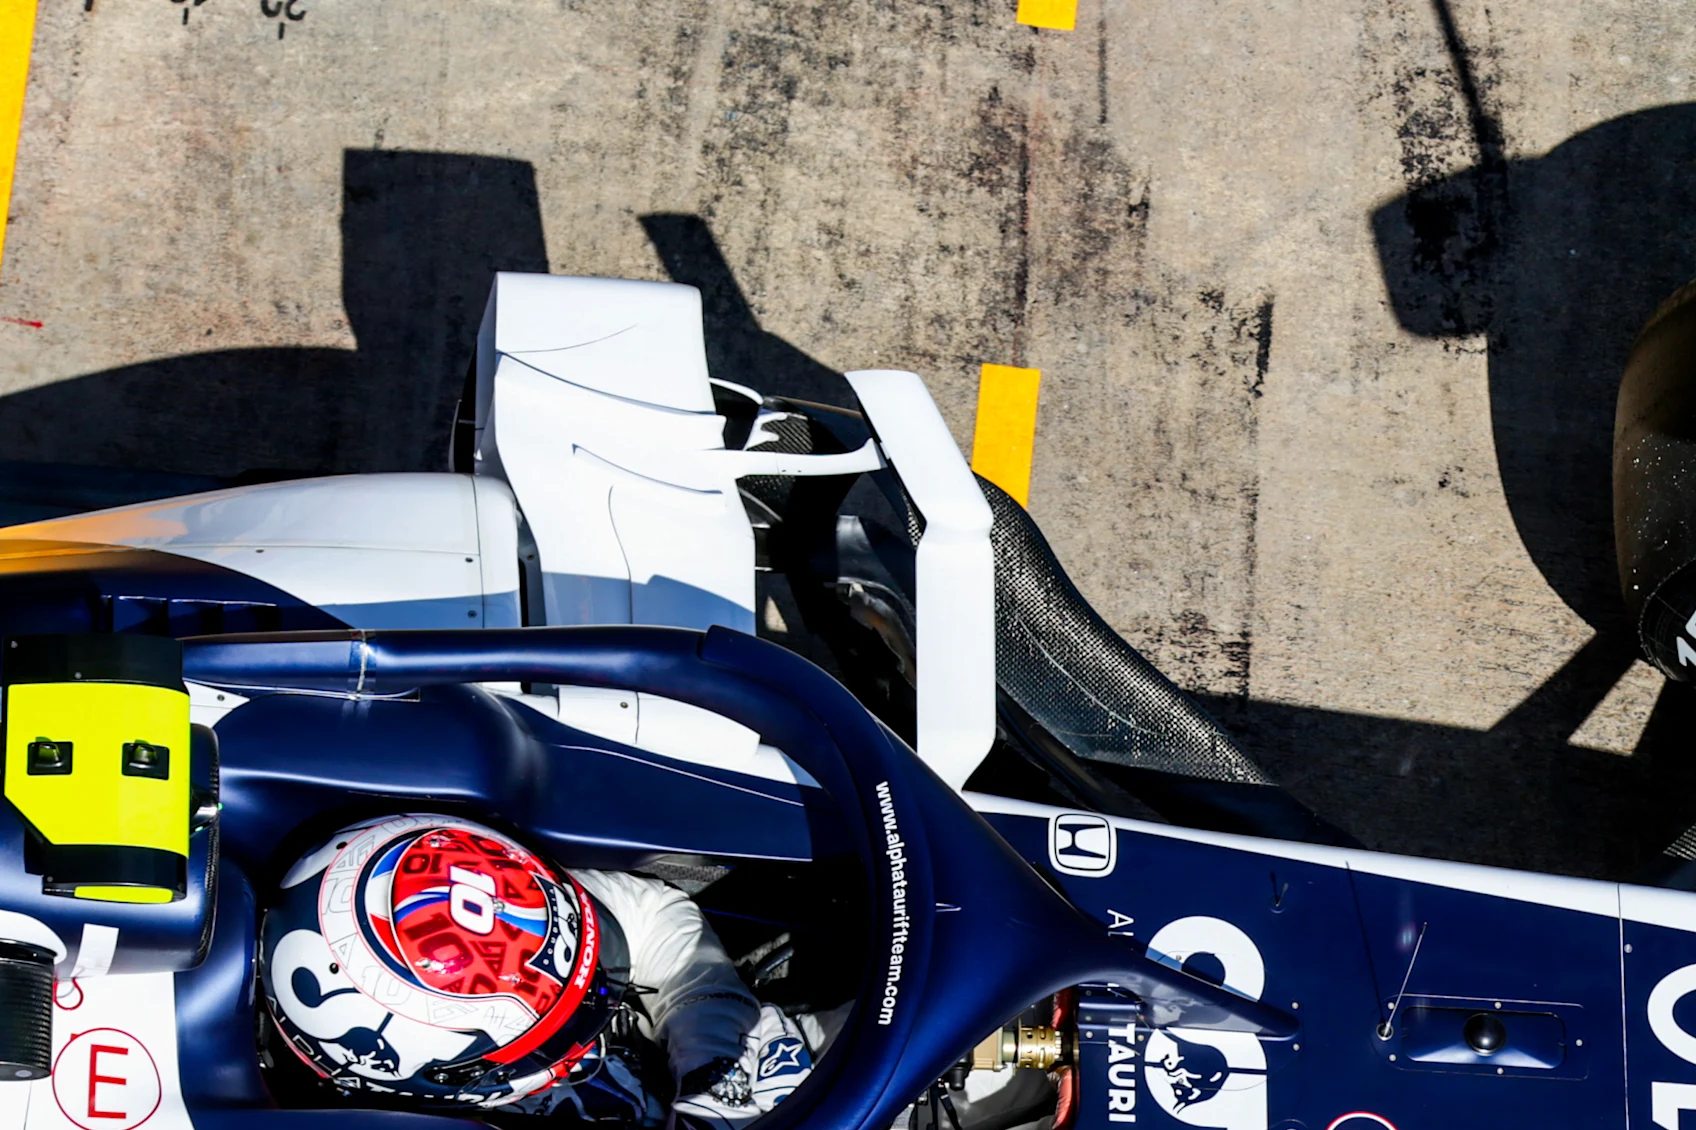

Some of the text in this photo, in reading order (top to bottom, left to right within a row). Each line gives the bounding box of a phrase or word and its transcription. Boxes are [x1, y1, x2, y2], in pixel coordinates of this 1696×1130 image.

[449, 865, 497, 936] 10
[574, 891, 599, 990] HONDA
[874, 780, 914, 1027] www.alphataurif1team.com
[87, 1043, 129, 1119] E
